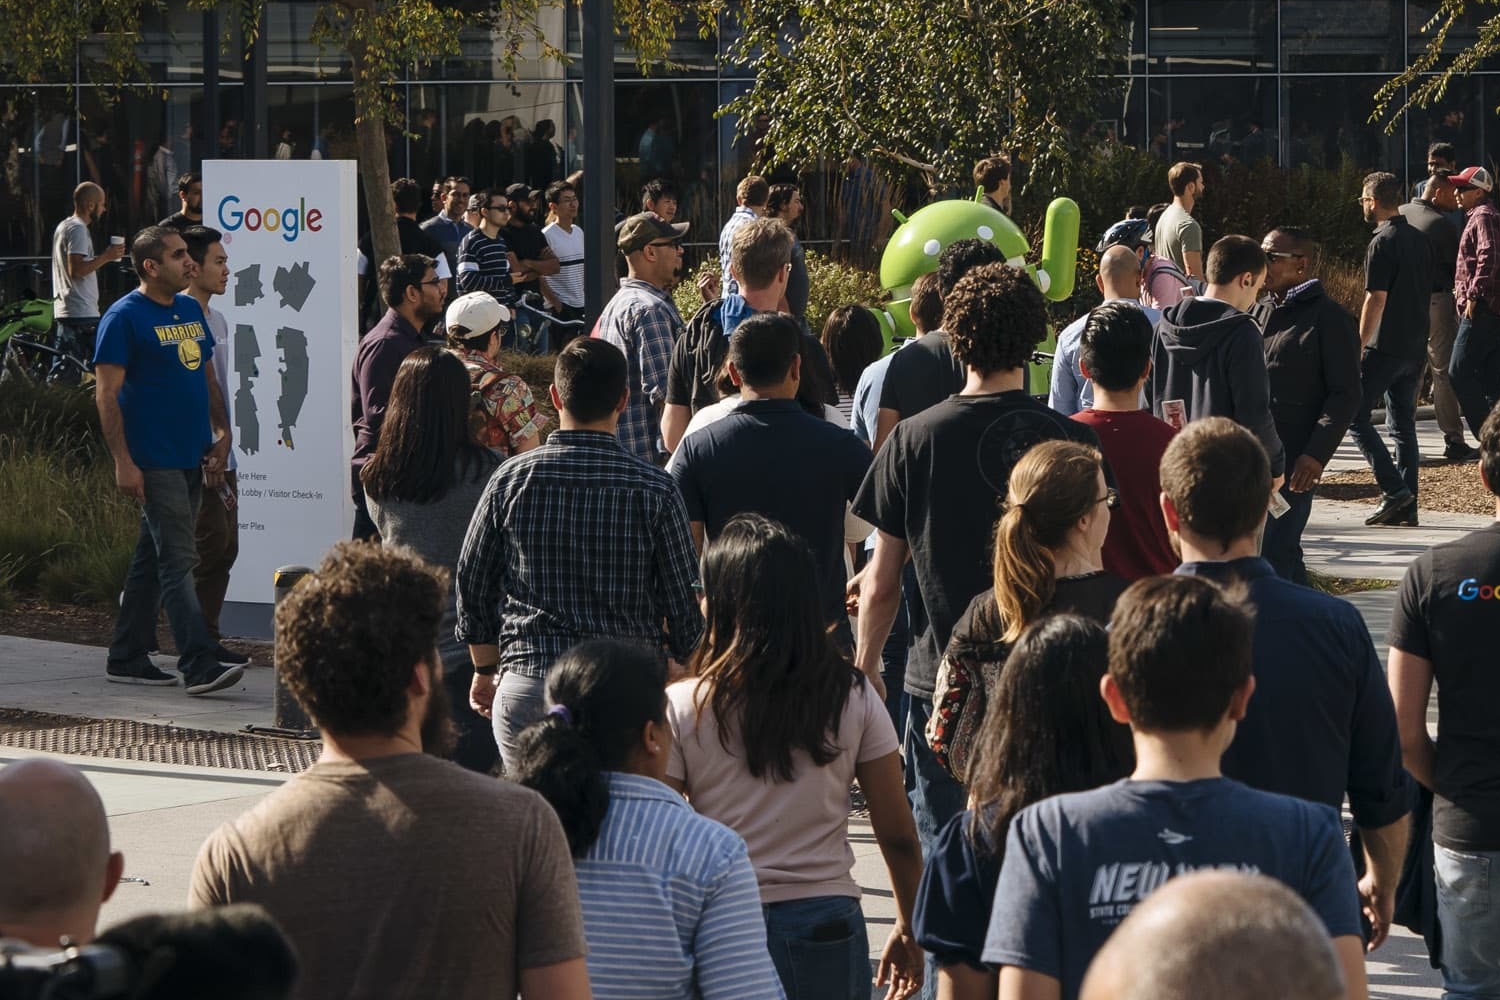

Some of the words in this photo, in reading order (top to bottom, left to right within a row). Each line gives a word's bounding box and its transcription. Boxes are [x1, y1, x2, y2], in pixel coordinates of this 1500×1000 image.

[218, 195, 323, 242] Google
[251, 472, 268, 481] Here
[241, 488, 263, 498] Lobby
[268, 489, 290, 498] Visitor
[291, 490, 324, 500] Check-In
[250, 521, 265, 531] Plex
